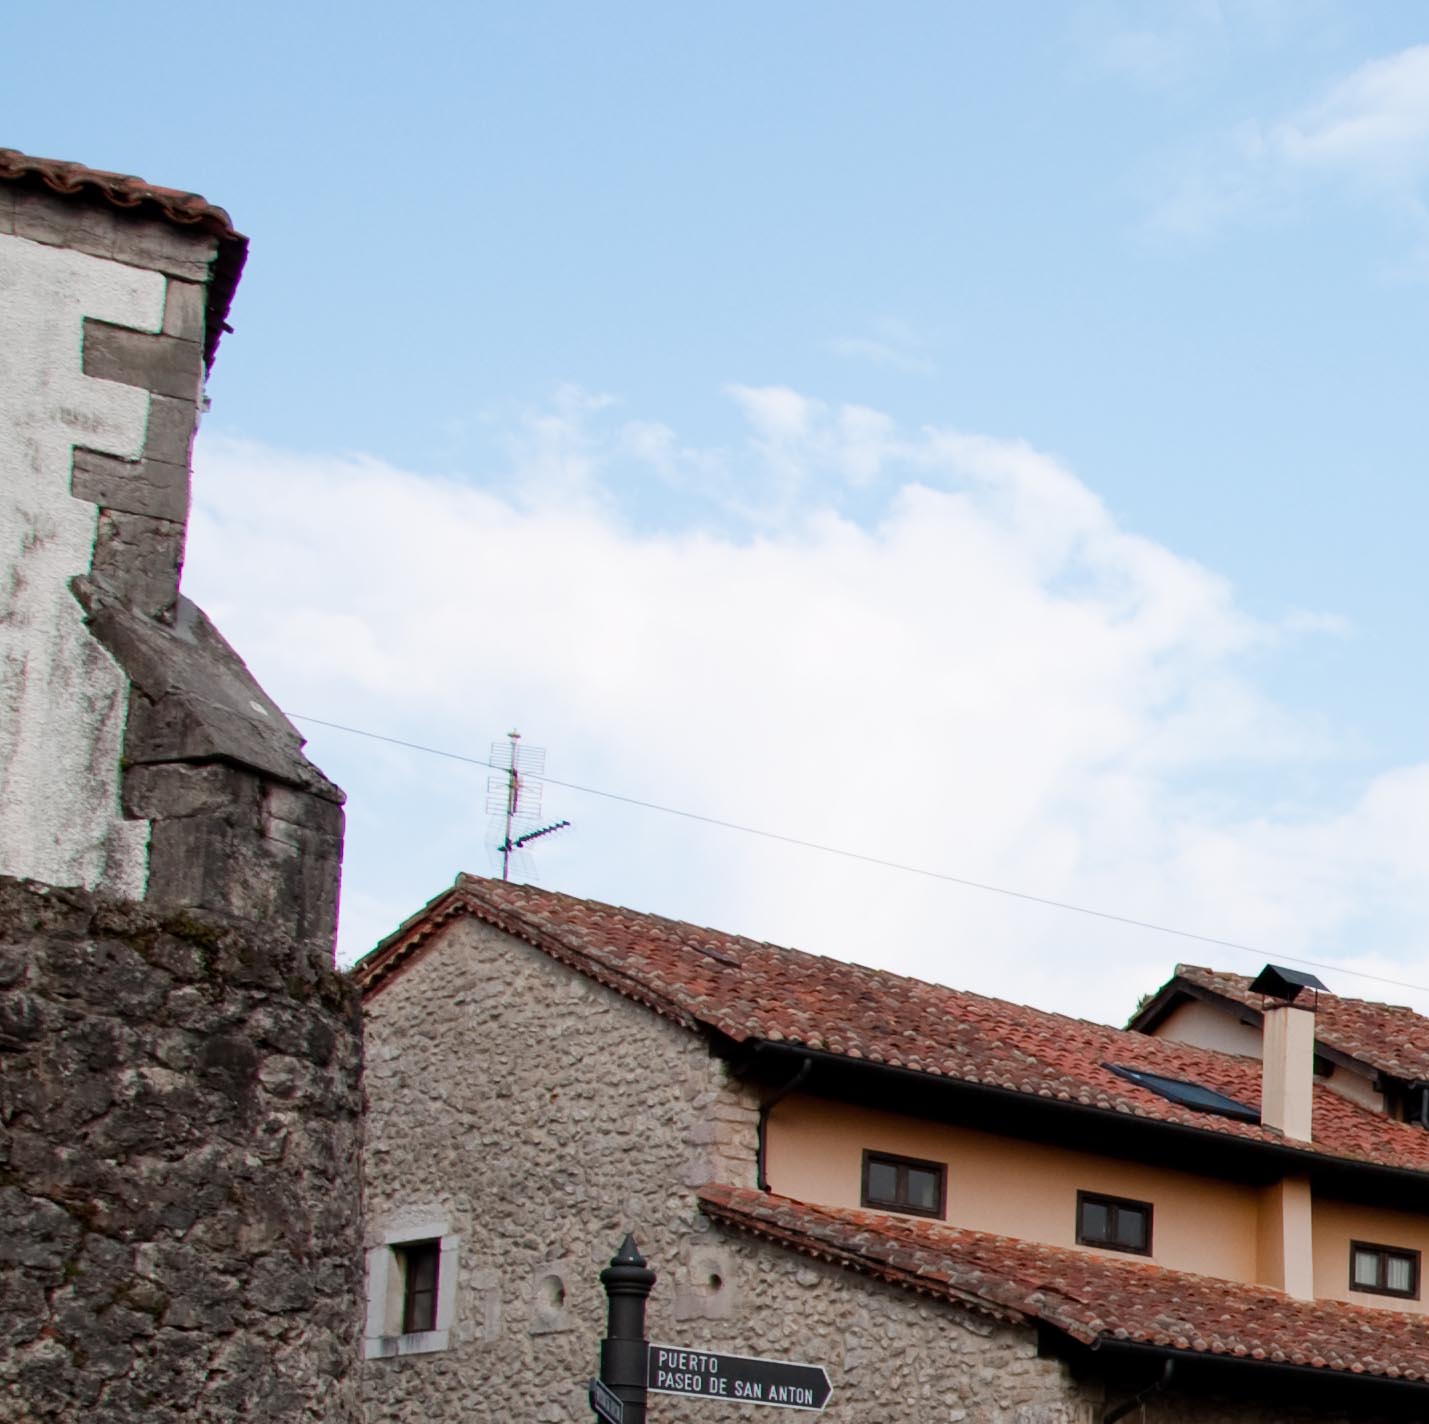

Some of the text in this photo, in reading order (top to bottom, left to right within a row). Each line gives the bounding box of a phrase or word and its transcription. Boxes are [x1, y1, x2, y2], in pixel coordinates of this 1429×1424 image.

[658, 1350, 718, 1374] PUERTO
[657, 1370, 813, 1405] PASEO DE SAN ANTON
